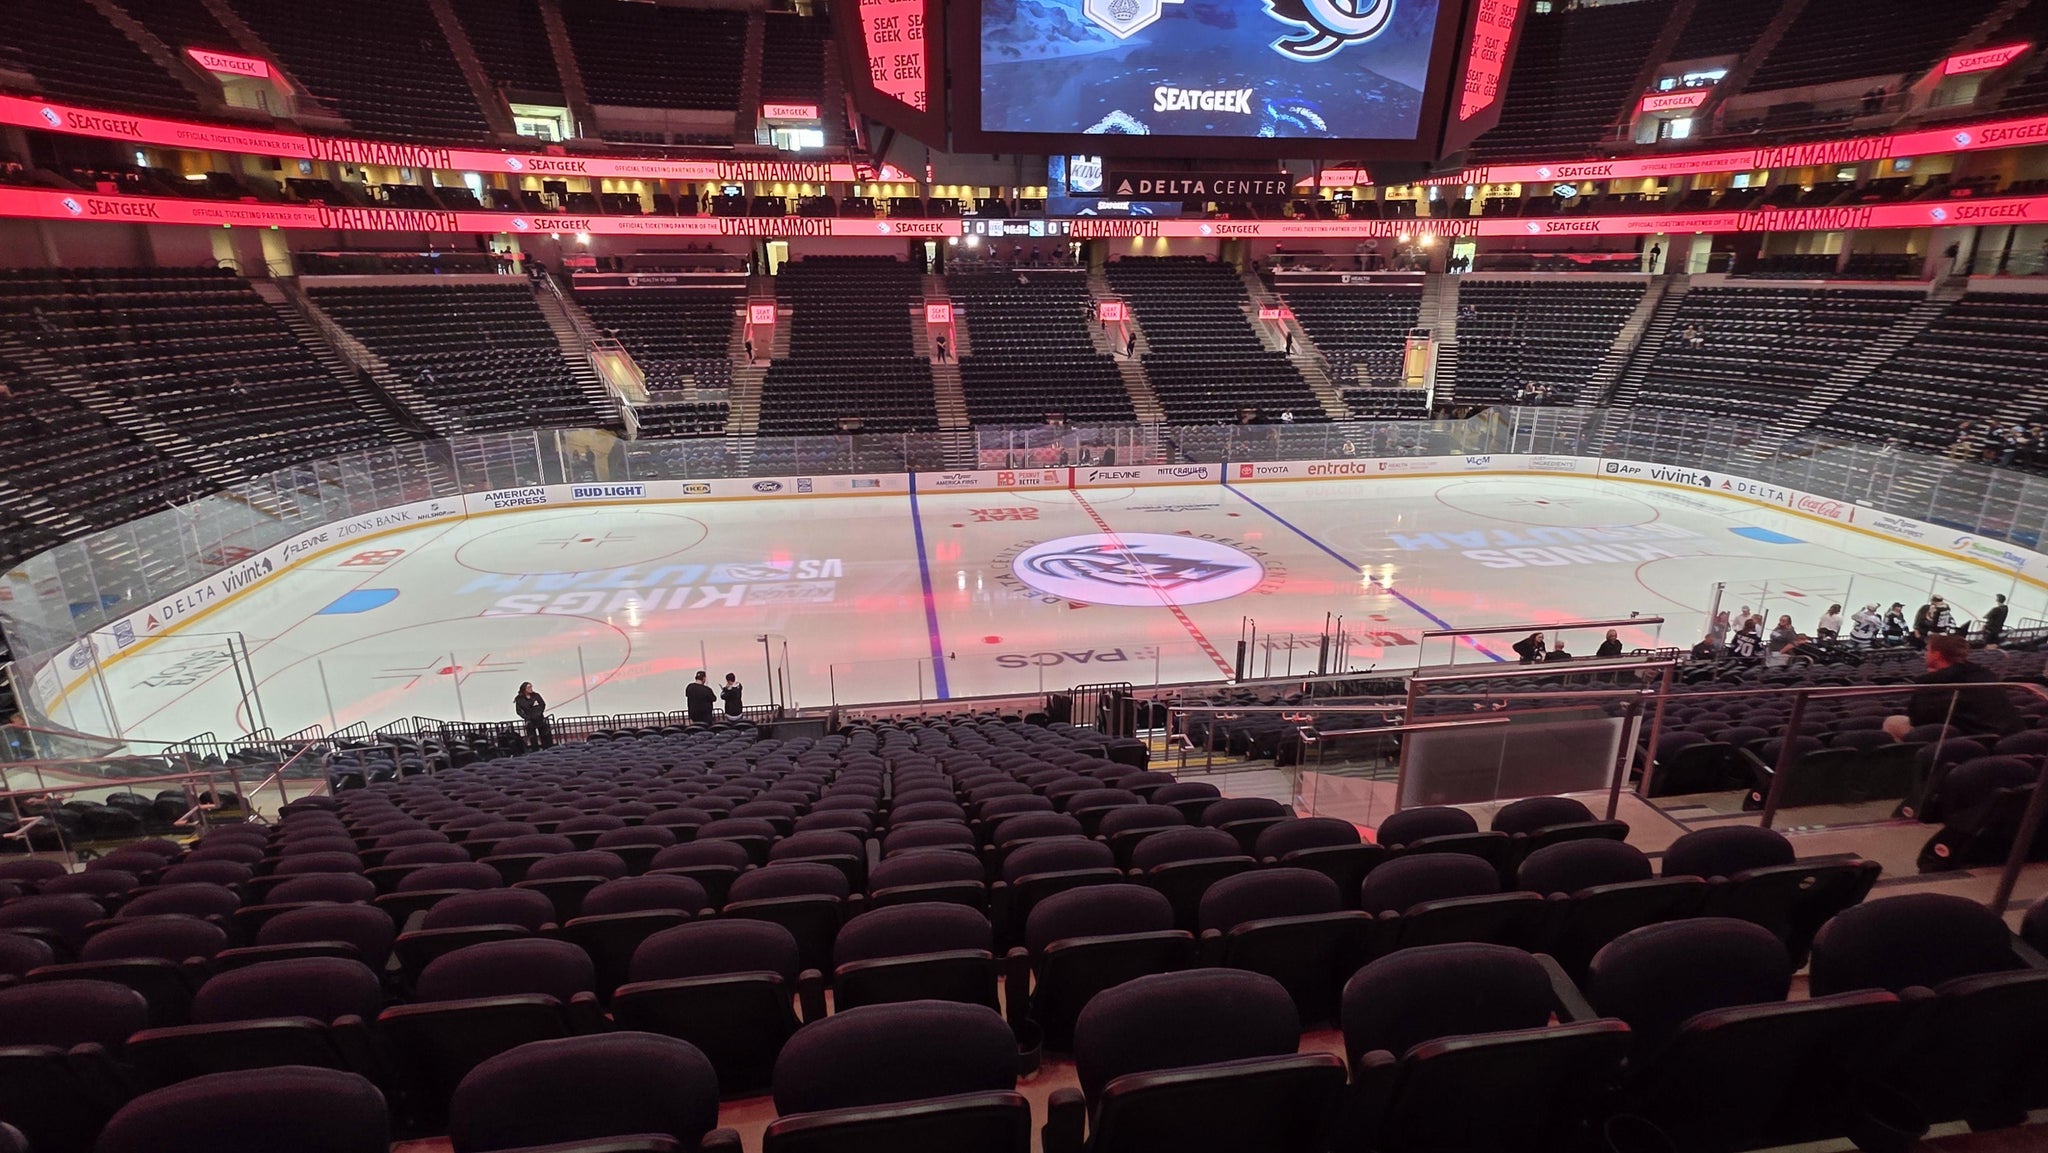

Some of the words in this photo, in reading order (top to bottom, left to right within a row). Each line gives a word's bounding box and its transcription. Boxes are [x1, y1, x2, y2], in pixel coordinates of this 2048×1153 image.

[874, 16, 899, 30] SEAT
[1480, 11, 1496, 25] GEEK
[874, 29, 902, 43] GEEK
[1484, 36, 1500, 49] SEAT
[894, 53, 920, 67] SEAT
[1481, 49, 1498, 62] GEEK
[1958, 51, 2012, 69] SEATGEEK
[203, 55, 256, 73] SEATGEEK
[894, 66, 921, 80] GEEK
[1468, 69, 1483, 82] SEAT
[1465, 82, 1481, 94] GEEK
[1153, 85, 1253, 114] SEATGEEK
[1653, 96, 1695, 107] SEATGEEK
[772, 107, 809, 116] SEATGEEK
[67, 112, 143, 137] SEATGEEK
[176, 131, 209, 142] OFFICIAL
[210, 134, 248, 145] TICKETING
[249, 139, 281, 149] PARTNER
[292, 144, 306, 152] THE
[306, 137, 355, 162] UTAH
[358, 142, 452, 170] MAMMOTH
[1641, 163, 1667, 171] OFFICIAL
[1669, 161, 1700, 170] TICKETING
[1701, 159, 1728, 169] PARTNER
[1729, 158, 1739, 166] OF
[1753, 147, 1801, 169] UTAH
[1801, 138, 1892, 166] MAMMOTH
[529, 158, 588, 173] SEATGEEK
[717, 163, 753, 181] UTAH
[758, 163, 832, 181] MAMMOTH
[1557, 165, 1613, 178] SEATGEEK
[1139, 179, 1206, 195] DELTA
[1213, 180, 1287, 195] CENTER
[88, 199, 159, 218] SEATGEEK
[1955, 202, 2031, 220] SEATGEEK
[192, 209, 223, 217] OFFICIAL
[225, 210, 261, 219] TICKETING
[262, 211, 292, 220] PARTNER
[318, 207, 363, 229] UTAH
[367, 209, 459, 231] MAMMOTH
[534, 218, 592, 231] SEATGEEK
[1655, 220, 1684, 228] TICKETING
[1686, 219, 1714, 227] PARTNER
[1736, 212, 1777, 231] UTAH
[1782, 207, 1871, 231] MAMMOTH
[719, 219, 755, 235] UTAH
[759, 219, 832, 236] MAMMOTH
[896, 223, 944, 233] SEATGEEK
[1093, 220, 1159, 237] MAMMOTH
[1216, 224, 1260, 235] SEATGEEK
[1369, 221, 1401, 237] UTAH
[1406, 220, 1479, 237] MAMMOTH
[1546, 221, 1600, 232] SEATGEEK
[1099, 471, 1140, 479] FILEVINE
[1257, 466, 1289, 474] TOYOTA
[1307, 461, 1366, 475] entrata
[575, 487, 602, 498] BUD
[605, 486, 643, 497] LIGHT
[684, 484, 710, 493] IKEA
[758, 482, 778, 491] Ford
[1738, 482, 1784, 502] DELTA
[485, 488, 545, 501] AMERICAN
[494, 496, 547, 508] EXPRESS
[969, 507, 1039, 516] GEEK
[974, 514, 1040, 522] SEAT
[337, 519, 373, 538] ZIONS
[377, 511, 411, 528] BANK
[289, 532, 329, 554] FILEVINE
[1199, 532, 1269, 558] DELTA
[799, 558, 843, 579] VS
[995, 573, 1060, 604] DELTA
[163, 585, 216, 620] DELTA
[479, 585, 747, 616] KINGS
[995, 647, 1128, 668] PACS
[130, 650, 217, 688] ZIONS
